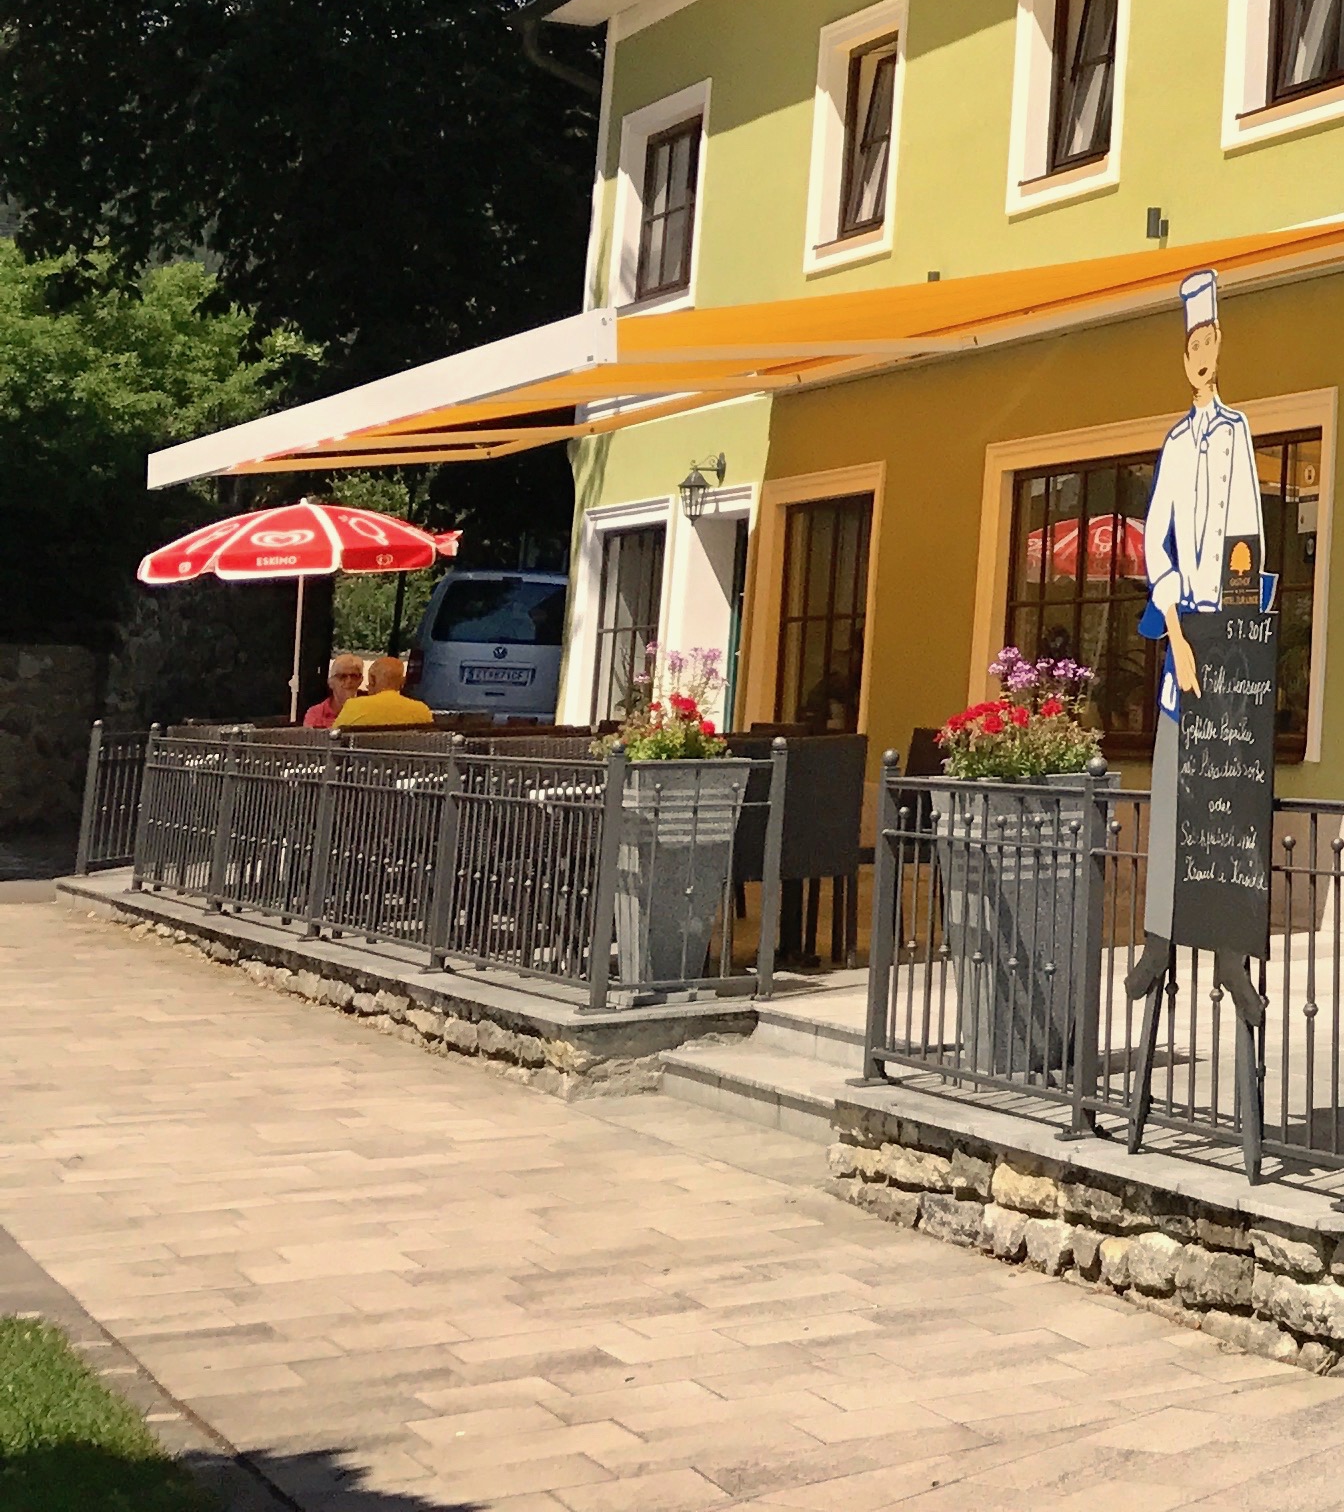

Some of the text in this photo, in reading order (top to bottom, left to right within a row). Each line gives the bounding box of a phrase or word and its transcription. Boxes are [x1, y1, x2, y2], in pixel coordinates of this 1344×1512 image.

[256, 555, 298, 567] ESKIMO
[1208, 797, 1233, 815] oder
[1183, 855, 1216, 882] Kraut
